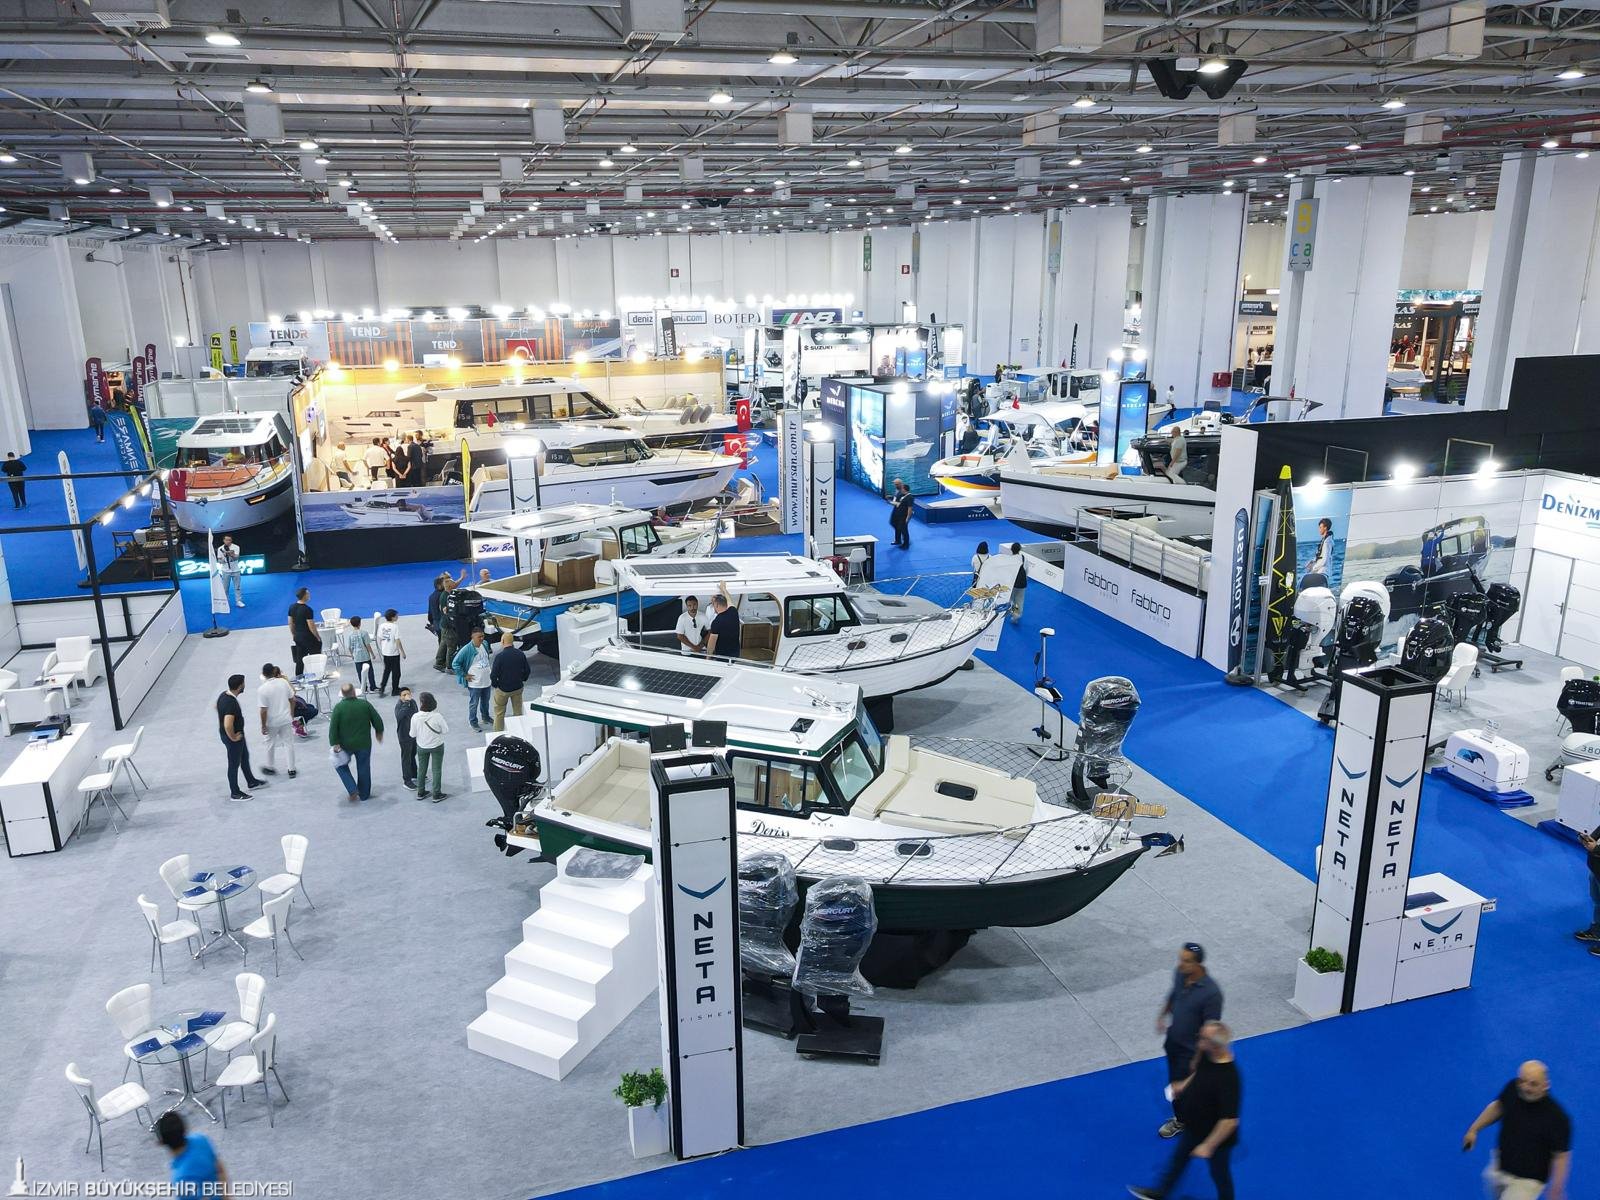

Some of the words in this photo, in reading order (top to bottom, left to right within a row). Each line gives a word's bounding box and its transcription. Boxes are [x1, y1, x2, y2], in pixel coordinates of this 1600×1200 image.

[789, 421, 798, 527] www.mursan.com.tr
[820, 489, 828, 524] NETA
[1083, 567, 1119, 596] fabbro
[1131, 588, 1171, 620] fabbro
[491, 756, 524, 770] MERCURY
[1333, 788, 1354, 870] NETA
[1383, 799, 1405, 878] NETA
[812, 906, 857, 915] MERCURY
[693, 911, 715, 1004] NETA
[1413, 933, 1463, 950] NETA
[681, 1010, 732, 1023] FISHER
